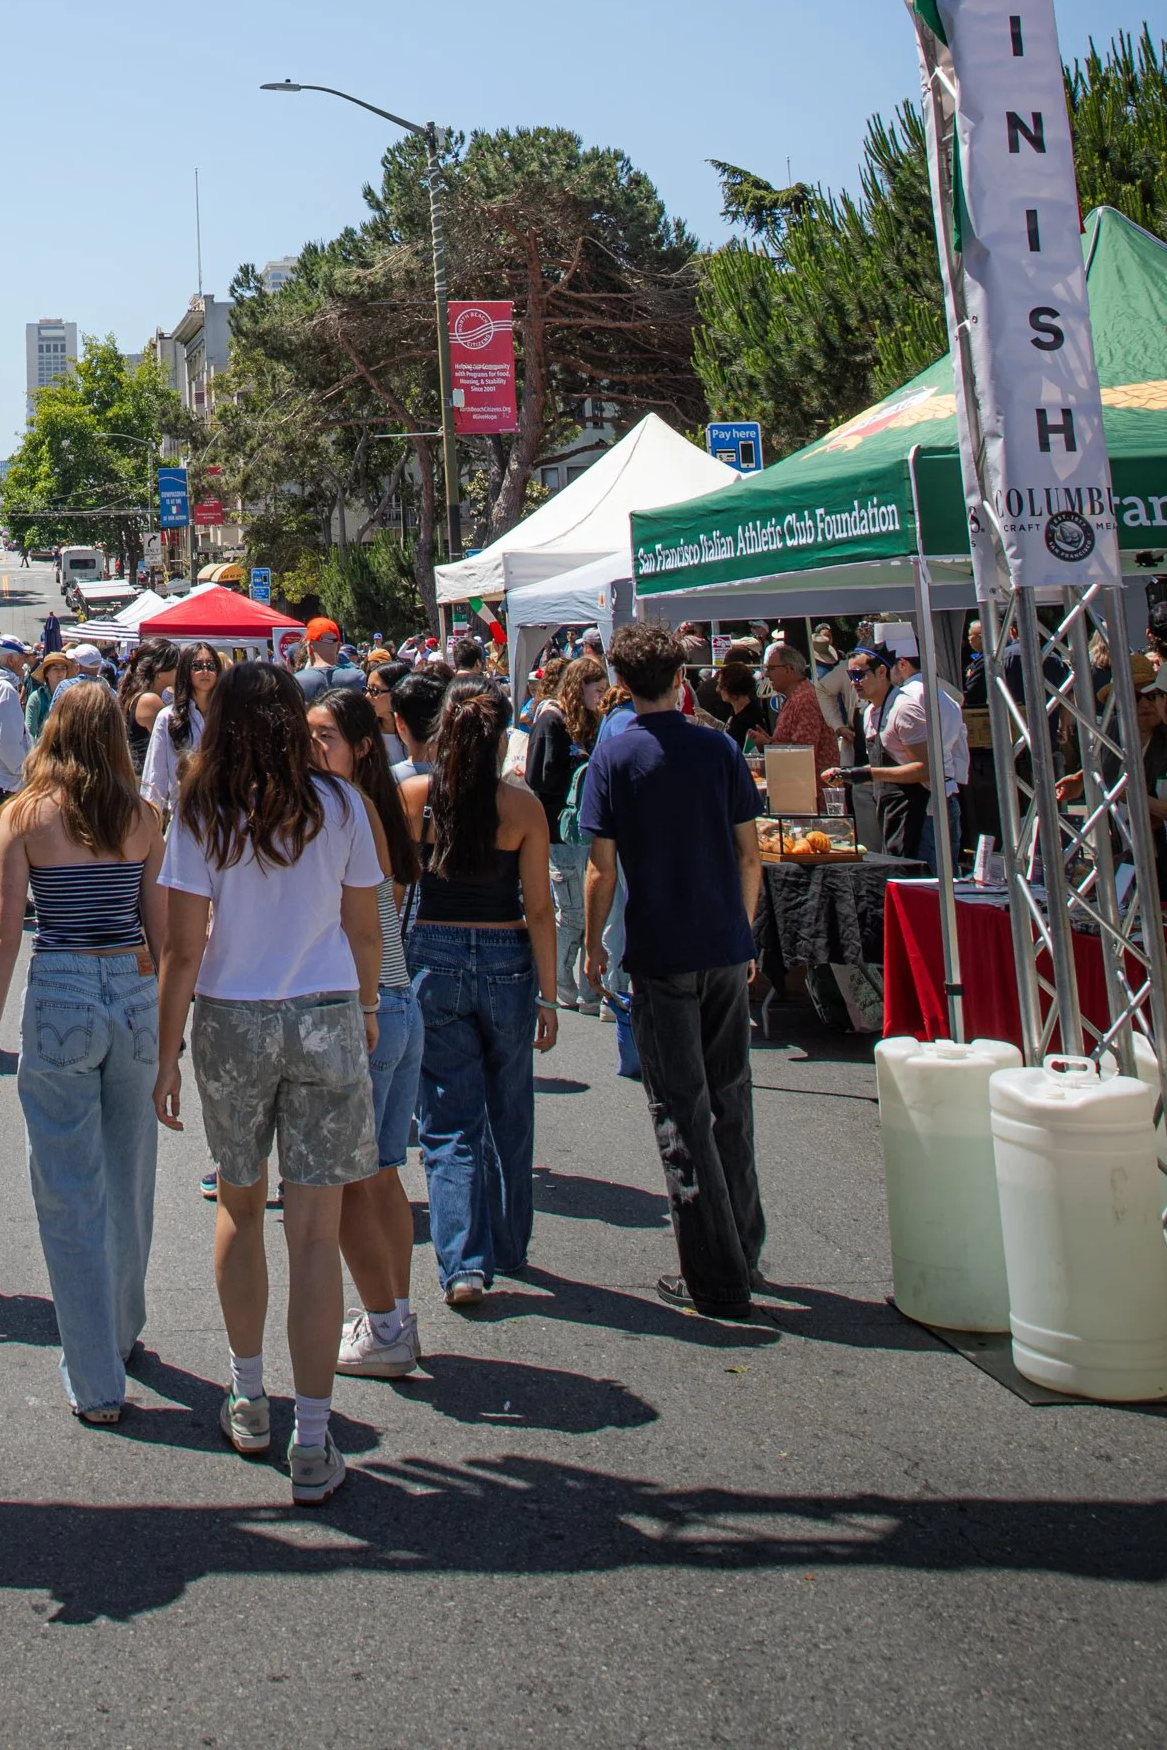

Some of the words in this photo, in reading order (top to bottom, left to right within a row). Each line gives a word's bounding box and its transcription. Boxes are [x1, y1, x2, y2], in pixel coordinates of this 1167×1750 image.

[458, 313, 470, 332] NORTH
[470, 311, 489, 325] BEACH
[466, 334, 491, 348] CITIZENS
[485, 378, 506, 386] Stability
[712, 429, 731, 441] Pay
[732, 428, 757, 438] here
[1003, 523, 1041, 532] CRAFT
[638, 547, 655, 575] San
[654, 538, 700, 571] Francisco
[699, 530, 735, 564] Italian
[736, 517, 784, 557] Athletic
[784, 510, 814, 547] Club
[815, 496, 900, 542] Foundation
[1048, 541, 1060, 553] SAN
[1060, 540, 1092, 559] FRANCISCO
